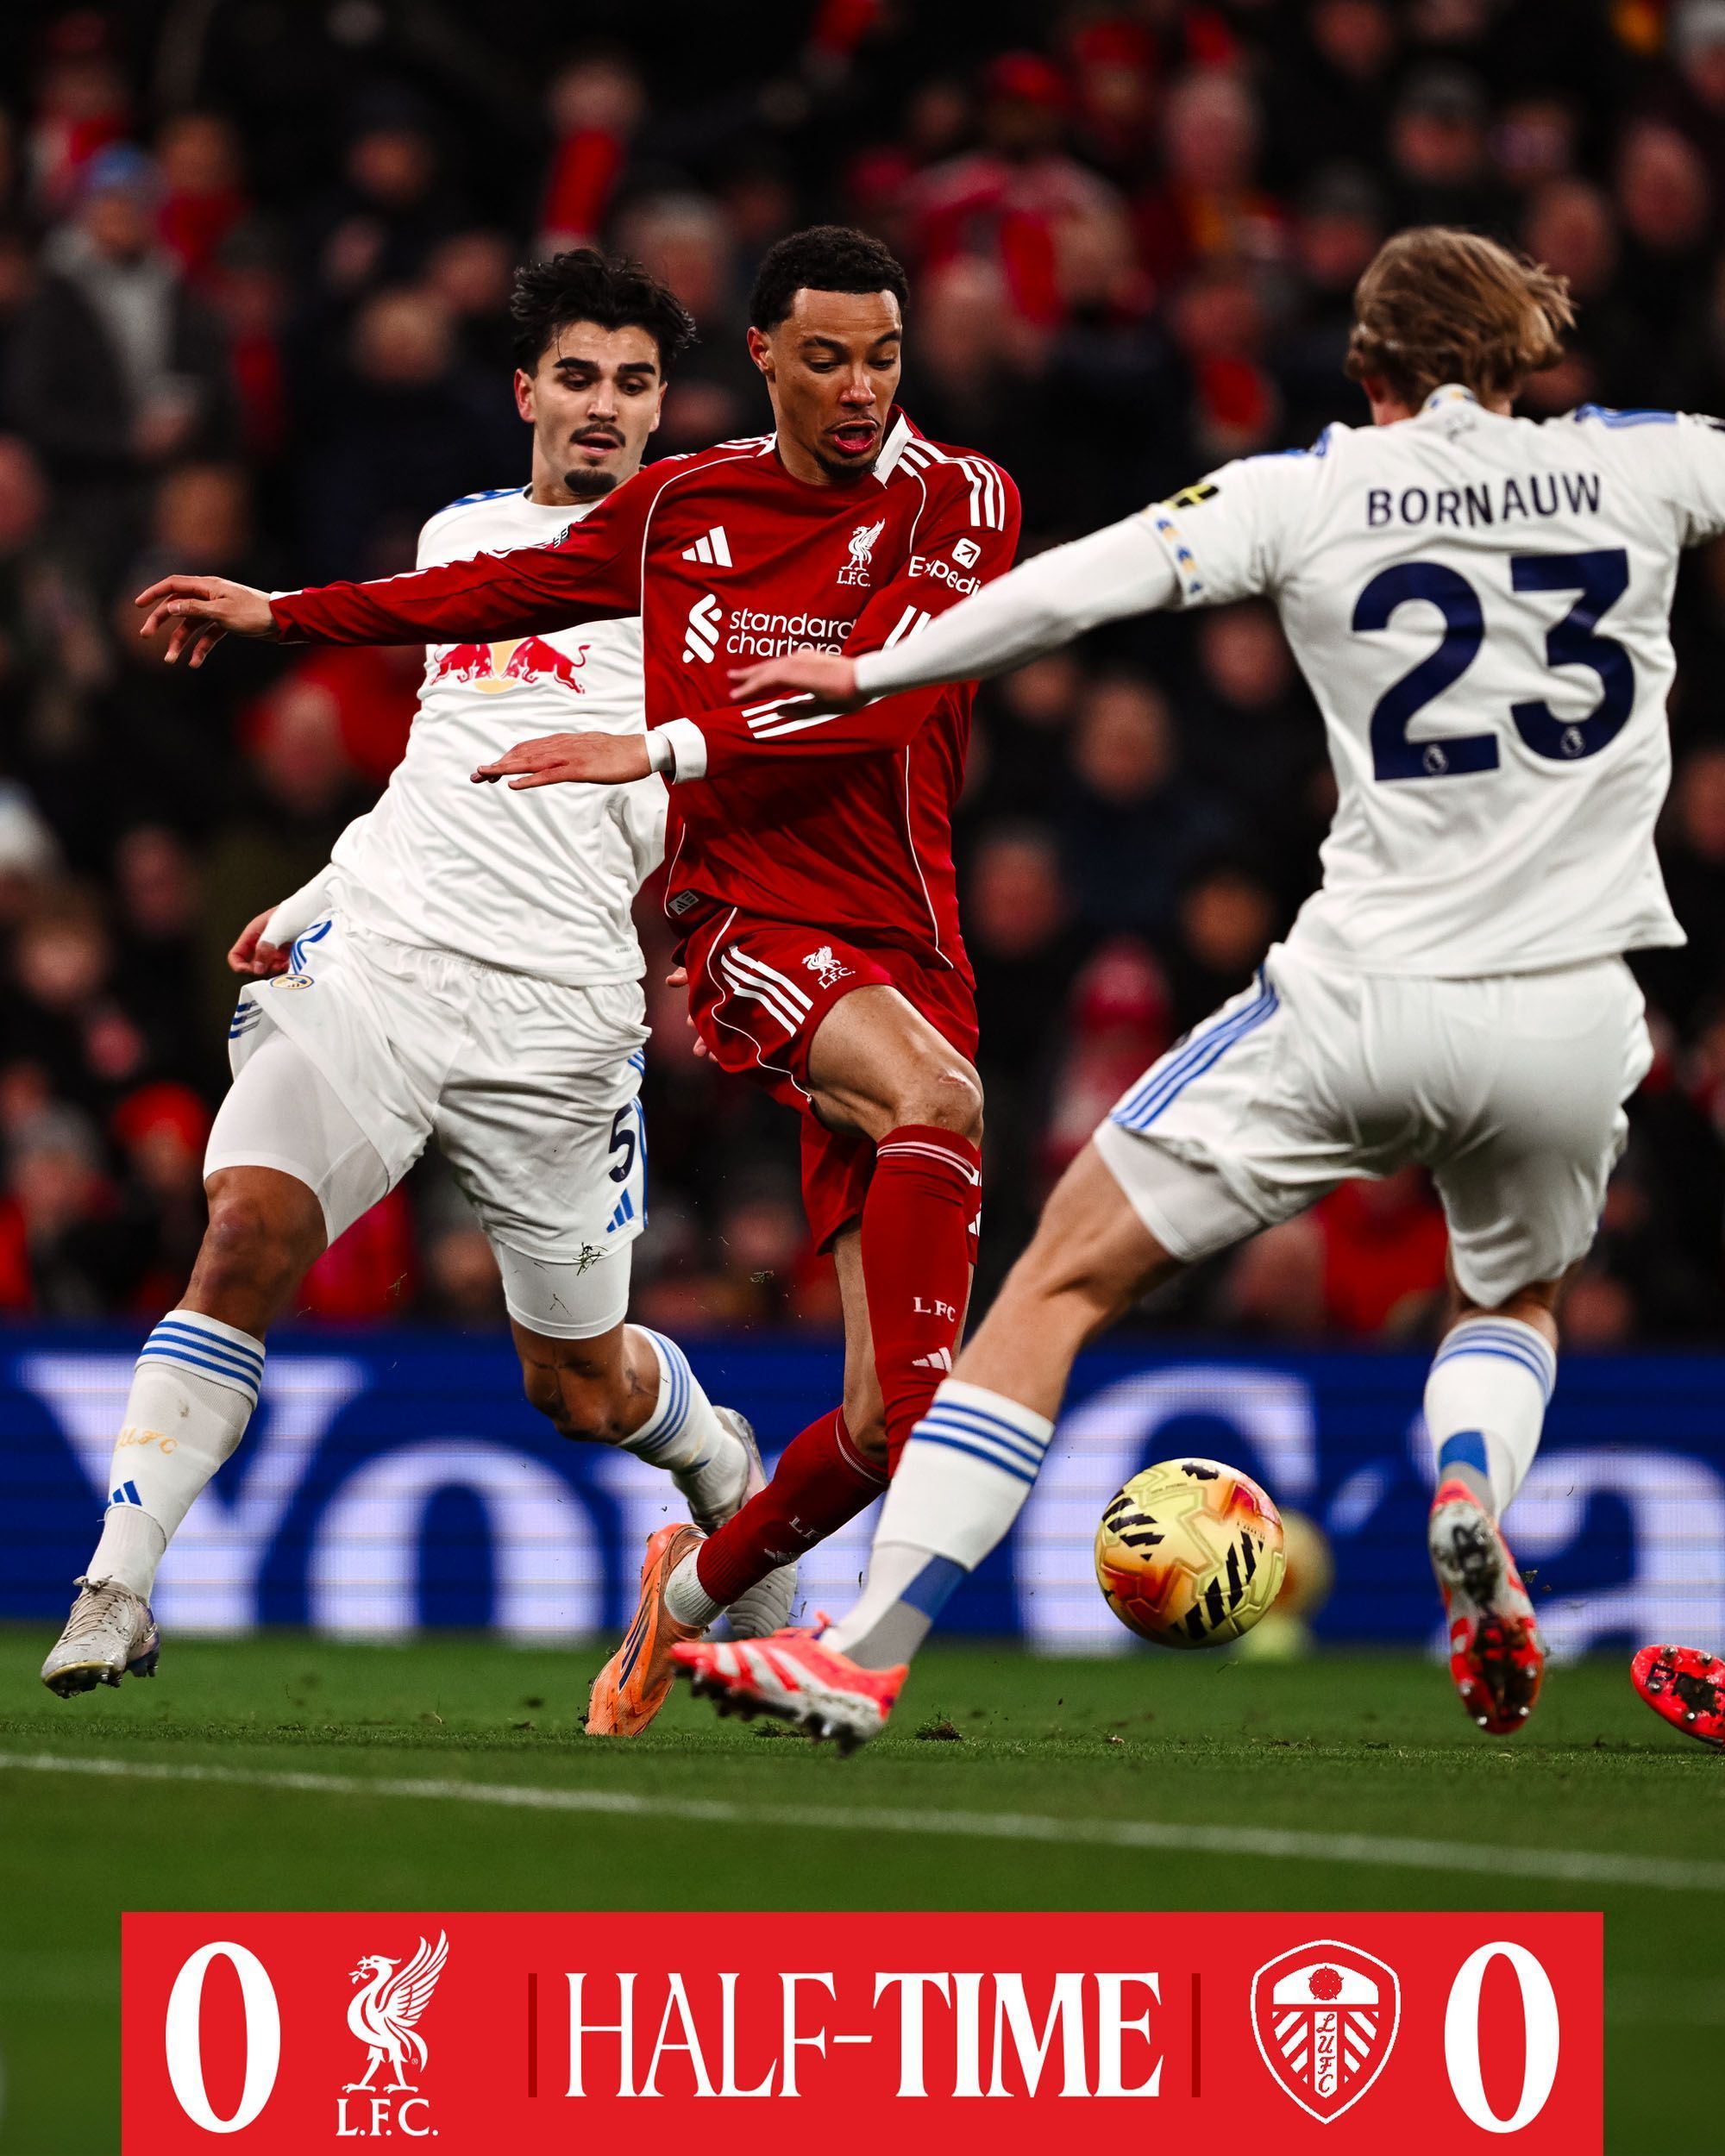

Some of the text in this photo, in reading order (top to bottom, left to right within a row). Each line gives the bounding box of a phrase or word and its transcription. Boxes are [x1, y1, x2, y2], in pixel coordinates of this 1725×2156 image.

[1367, 473, 1601, 528] BORNAUW
[836, 570, 871, 587] L.F.C.
[908, 555, 982, 598] Expedi
[726, 630, 843, 658] chartere
[1351, 547, 1636, 781] 23
[608, 1102, 636, 1183] 5
